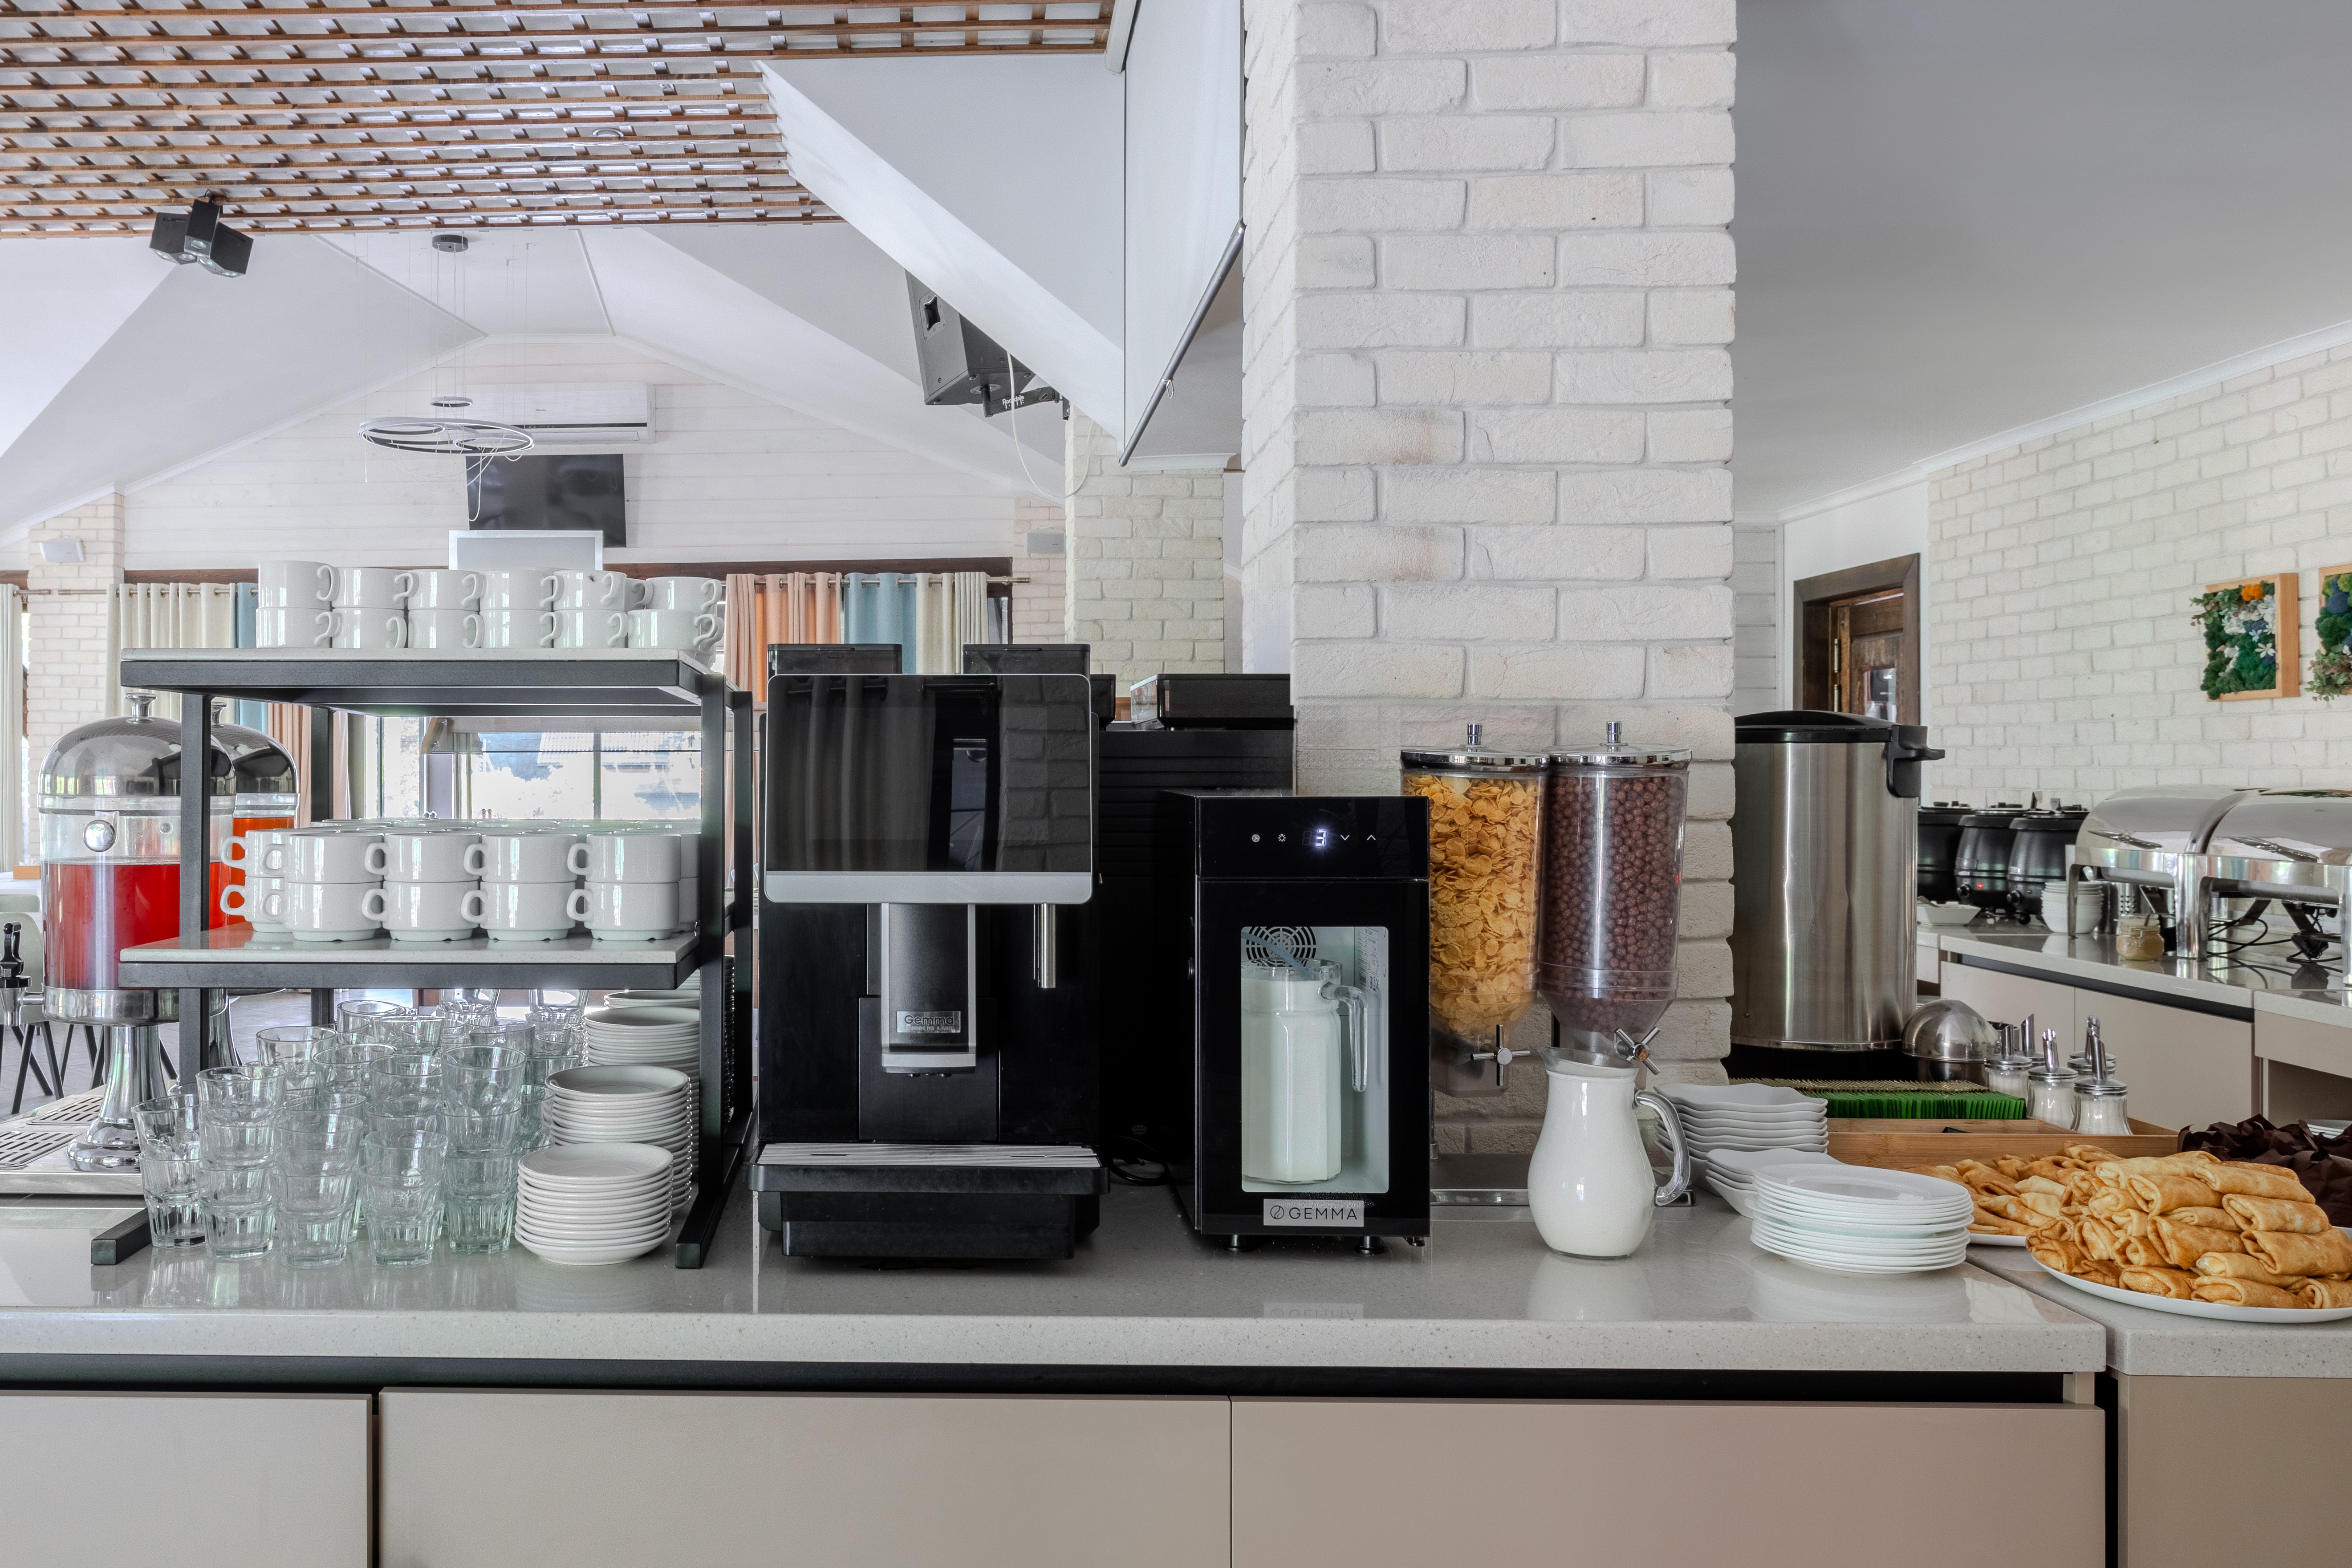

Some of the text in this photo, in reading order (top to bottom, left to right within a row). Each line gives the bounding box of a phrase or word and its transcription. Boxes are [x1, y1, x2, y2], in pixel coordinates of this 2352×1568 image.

[1002, 395, 1024, 409] Rocdale
[1316, 829, 1326, 846] 3
[904, 1014, 954, 1025] Gemma
[1288, 1207, 1358, 1220] GEMMA
